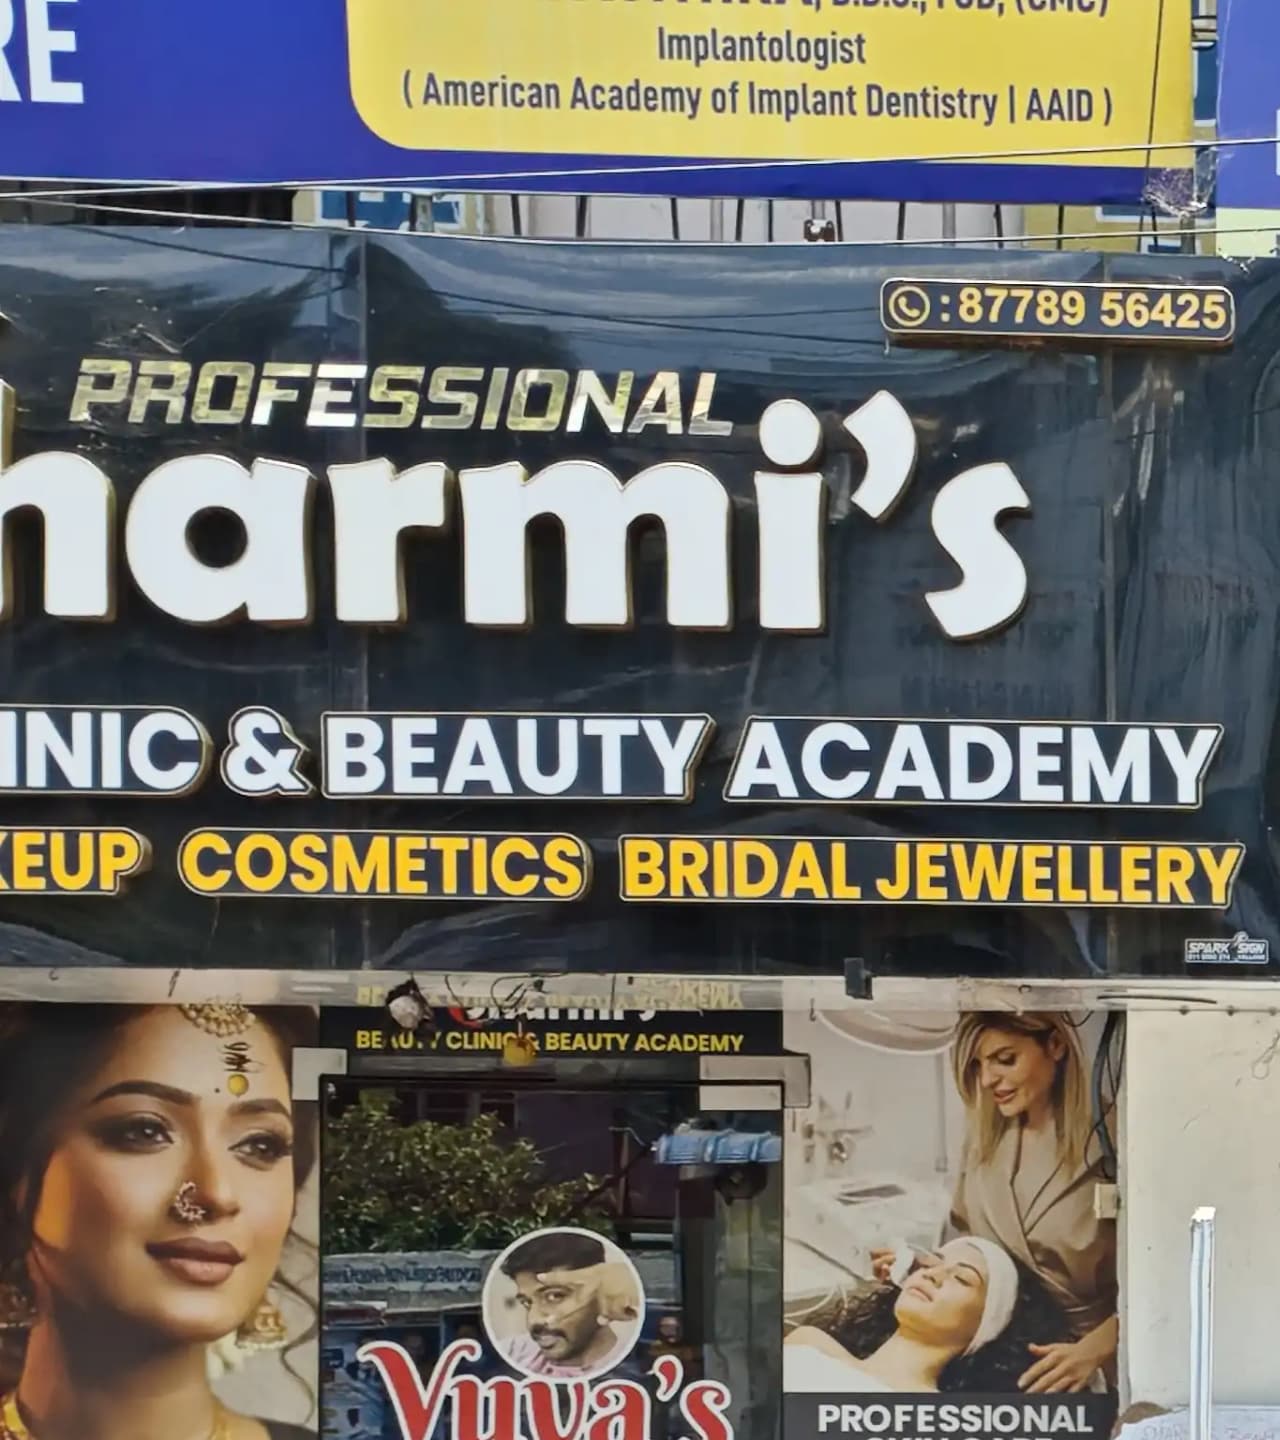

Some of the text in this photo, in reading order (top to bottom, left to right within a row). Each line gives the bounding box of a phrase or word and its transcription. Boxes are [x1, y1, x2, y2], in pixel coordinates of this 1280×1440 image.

[657, 27, 866, 68] Implantologist
[423, 73, 1092, 125] American Academy of Implant Dentistry AAID
[1098, 289, 1227, 332] 56425
[69, 358, 735, 437] PROFESSIONAL
[224, 709, 309, 796] &
[329, 714, 705, 797] BEAUTY
[730, 722, 1218, 805] ACADEMY
[181, 831, 584, 896] COSMETICS
[624, 836, 859, 901] BRIDAL
[877, 840, 1242, 906] JEWELLERY
[545, 1031, 746, 1053] BEAUTY ACADEMY
[818, 1404, 1094, 1433] PROFESSIONAL
